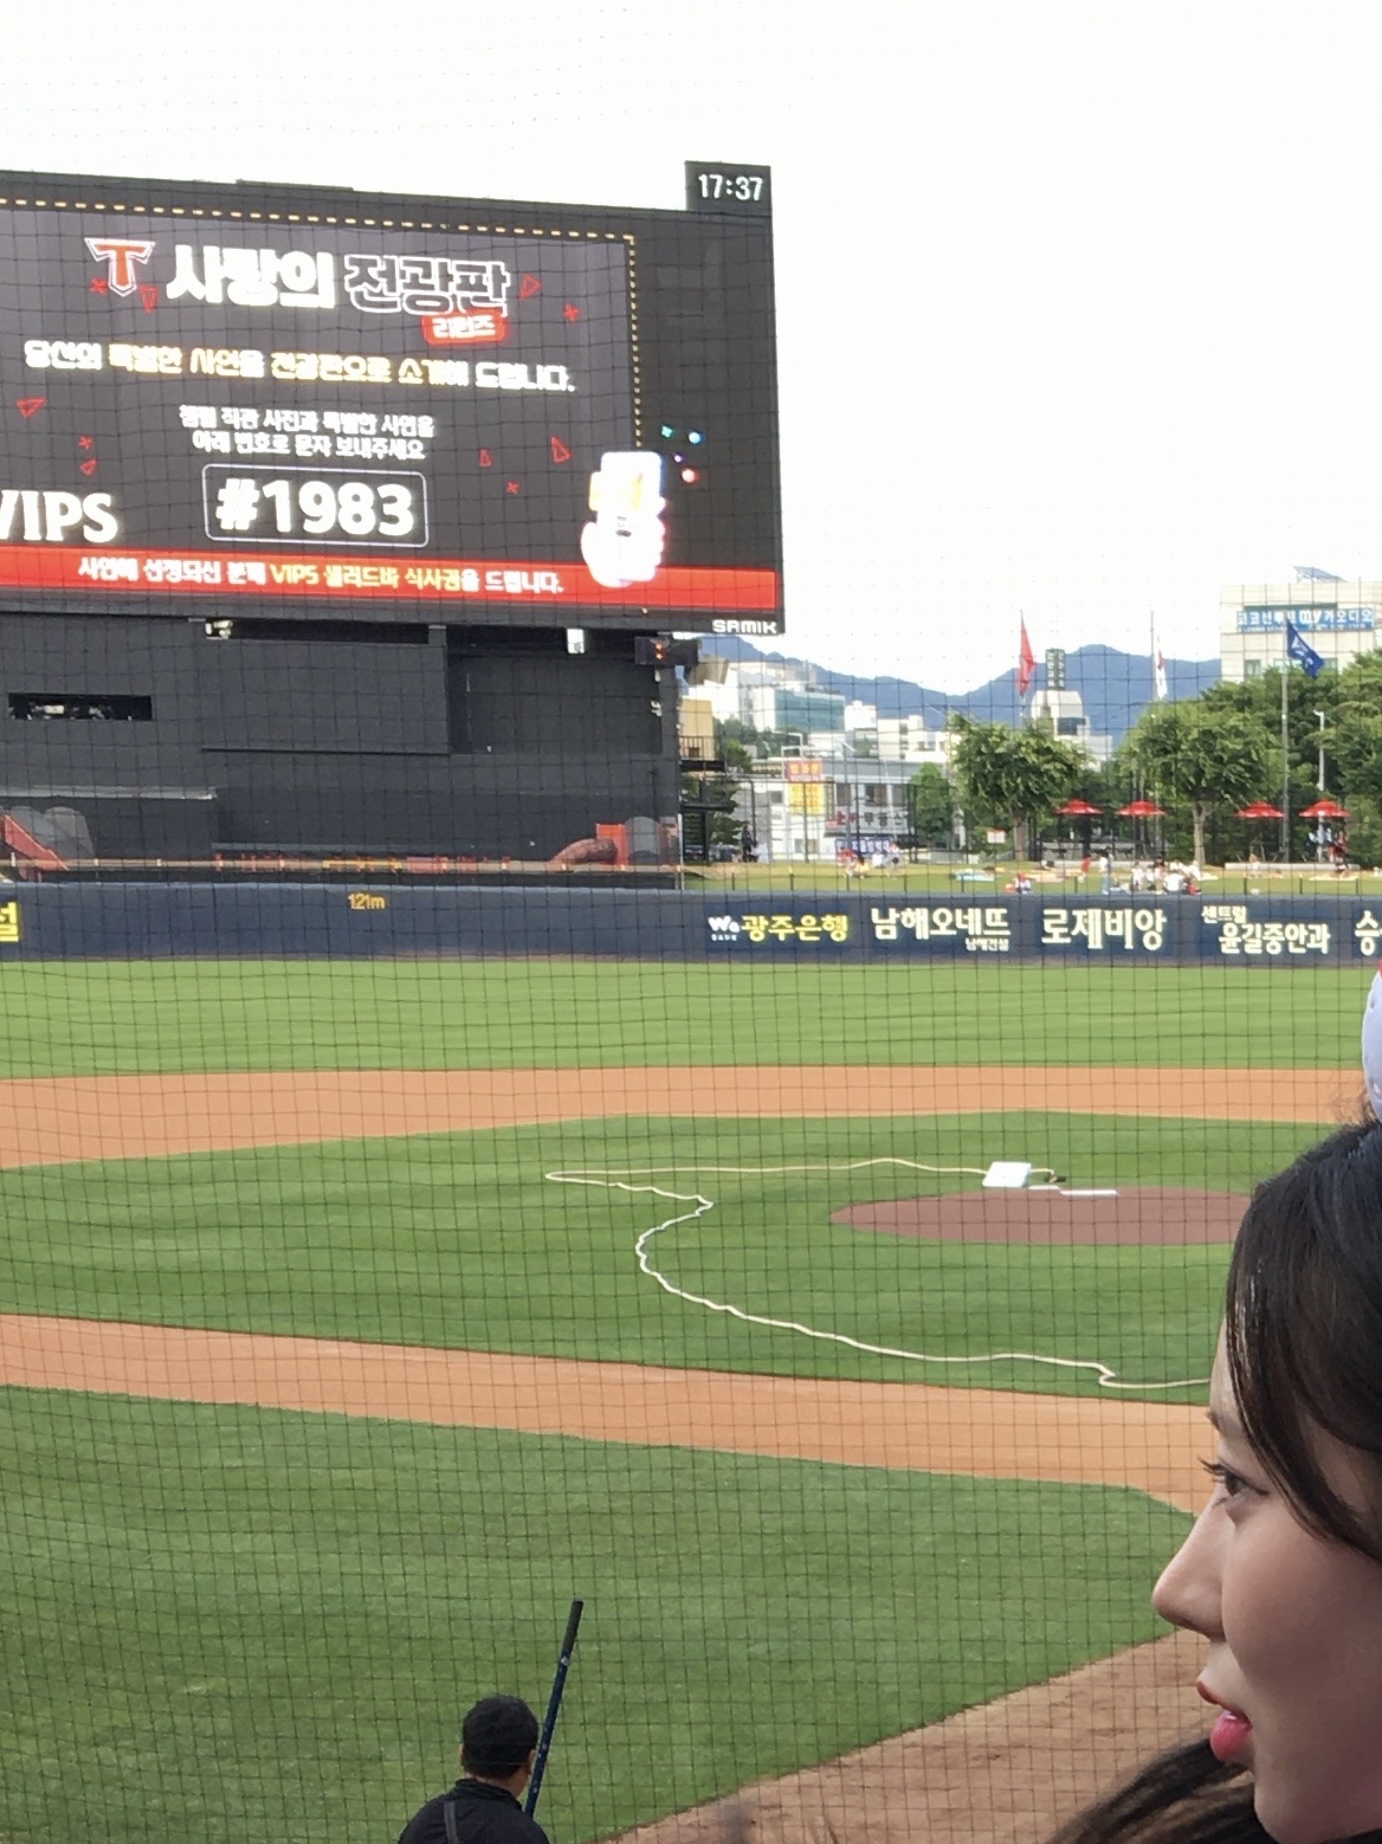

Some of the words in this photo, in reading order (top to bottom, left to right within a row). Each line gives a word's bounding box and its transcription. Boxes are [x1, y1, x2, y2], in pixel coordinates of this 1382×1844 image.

[698, 173, 763, 201] 17:37
[84, 238, 156, 296] T
[166, 245, 336, 309] 사랑의
[344, 253, 511, 319] 전광판
[24, 340, 102, 370] 당신의
[109, 343, 181, 374] 특별한
[190, 348, 264, 378] 사연을
[271, 352, 392, 384] 전광판으로
[475, 362, 576, 392] 드립니다.
[221, 407, 258, 429] 직관
[322, 412, 377, 435] 특별한
[381, 415, 434, 437] 사연을
[192, 430, 231, 453] 아래
[234, 432, 290, 454] 번호로
[295, 435, 331, 457] 문자
[335, 437, 426, 460] 보내주세요
[0, 490, 118, 543] VIPS
[215, 478, 414, 536] #1983
[270, 564, 318, 584] VIPS
[324, 565, 399, 588] 샐러드바
[405, 568, 479, 592] 식사권을
[485, 570, 564, 593] 드립니다.
[712, 619, 777, 634] SAMIK
[348, 893, 385, 909] 121m
[1201, 906, 1247, 924] 센트럴
[742, 915, 848, 941] 광주은행
[871, 907, 1011, 940] 남해오네뜨
[1042, 908, 1166, 951] 로제비앙
[1219, 923, 1330, 954] 윤길중안과
